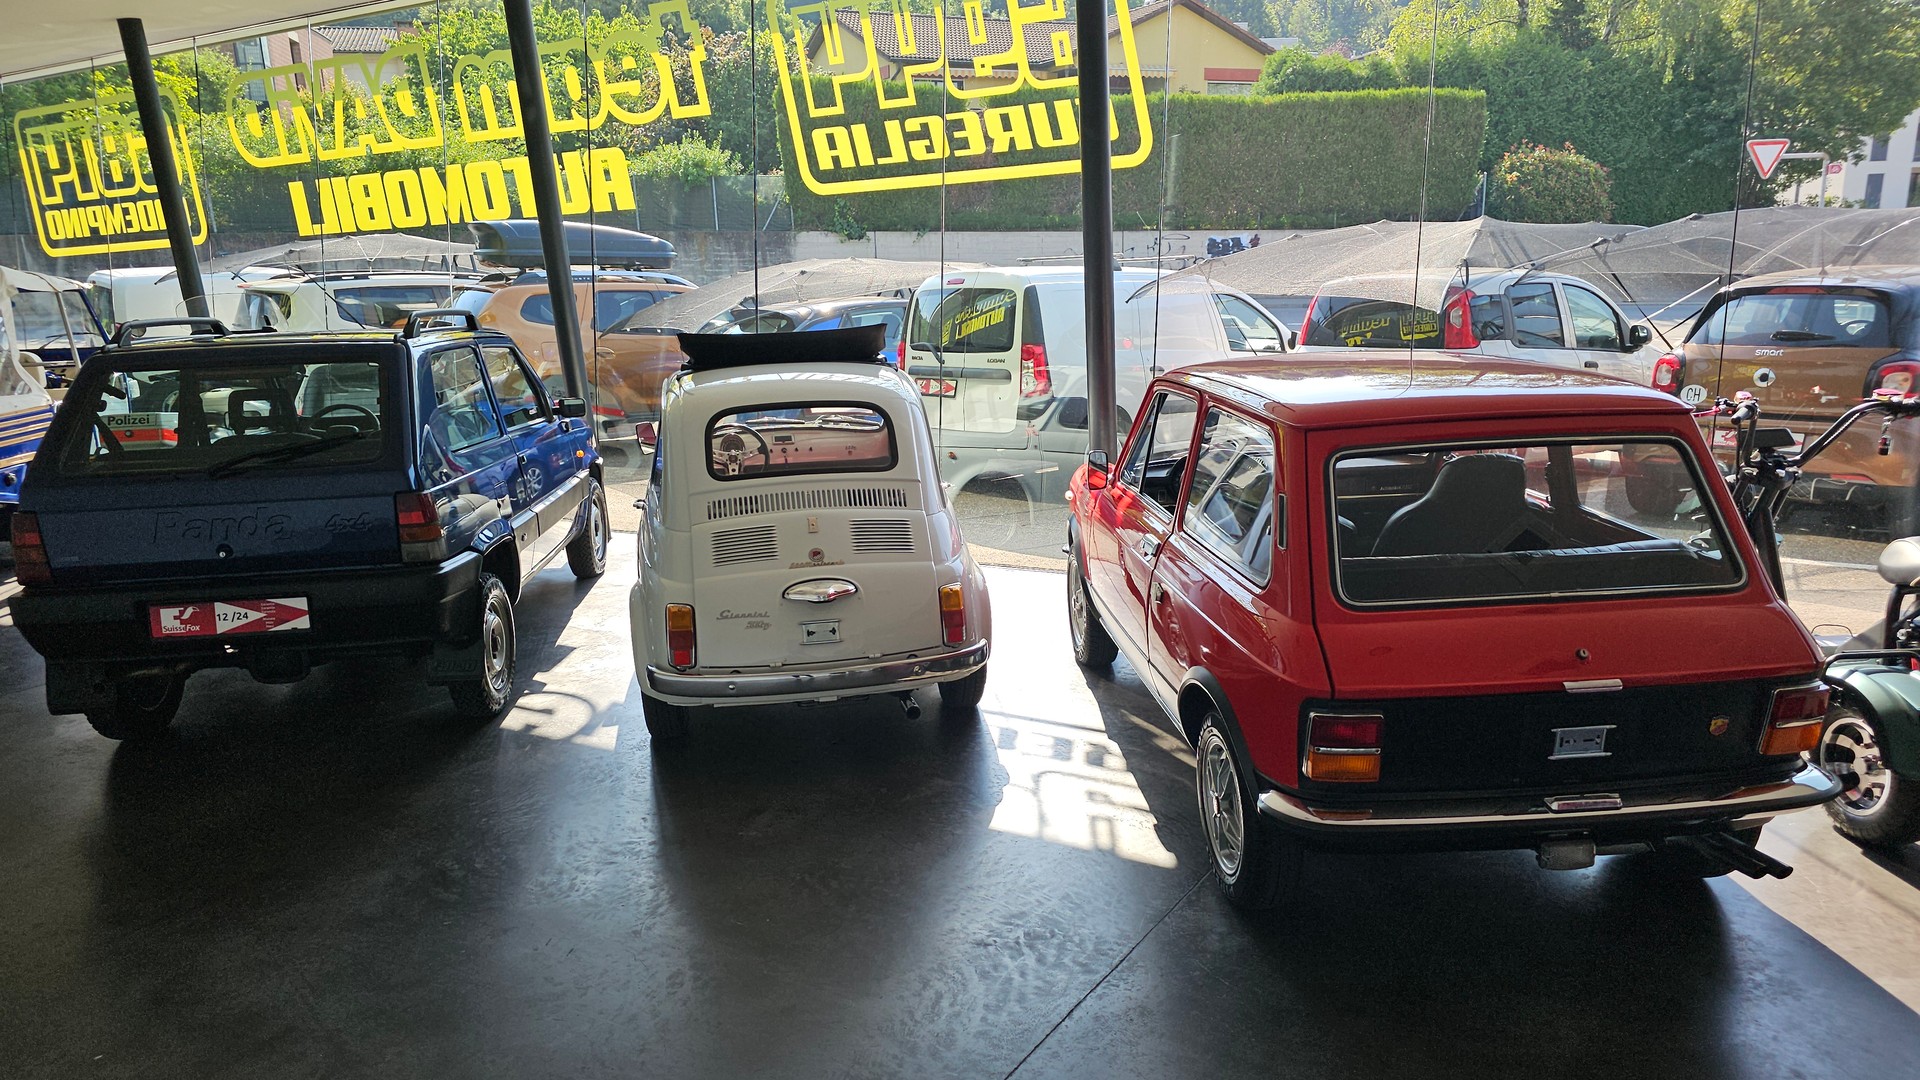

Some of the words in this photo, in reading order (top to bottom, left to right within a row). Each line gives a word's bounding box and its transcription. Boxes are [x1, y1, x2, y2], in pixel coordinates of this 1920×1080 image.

[1755, 348, 1784, 357] smart
[1686, 387, 1702, 402] CH
[107, 414, 150, 426] Polizei
[152, 506, 292, 544] Panda
[324, 511, 372, 533] 4x4
[716, 609, 770, 621] Giannini
[162, 624, 201, 633] SuisseFox
